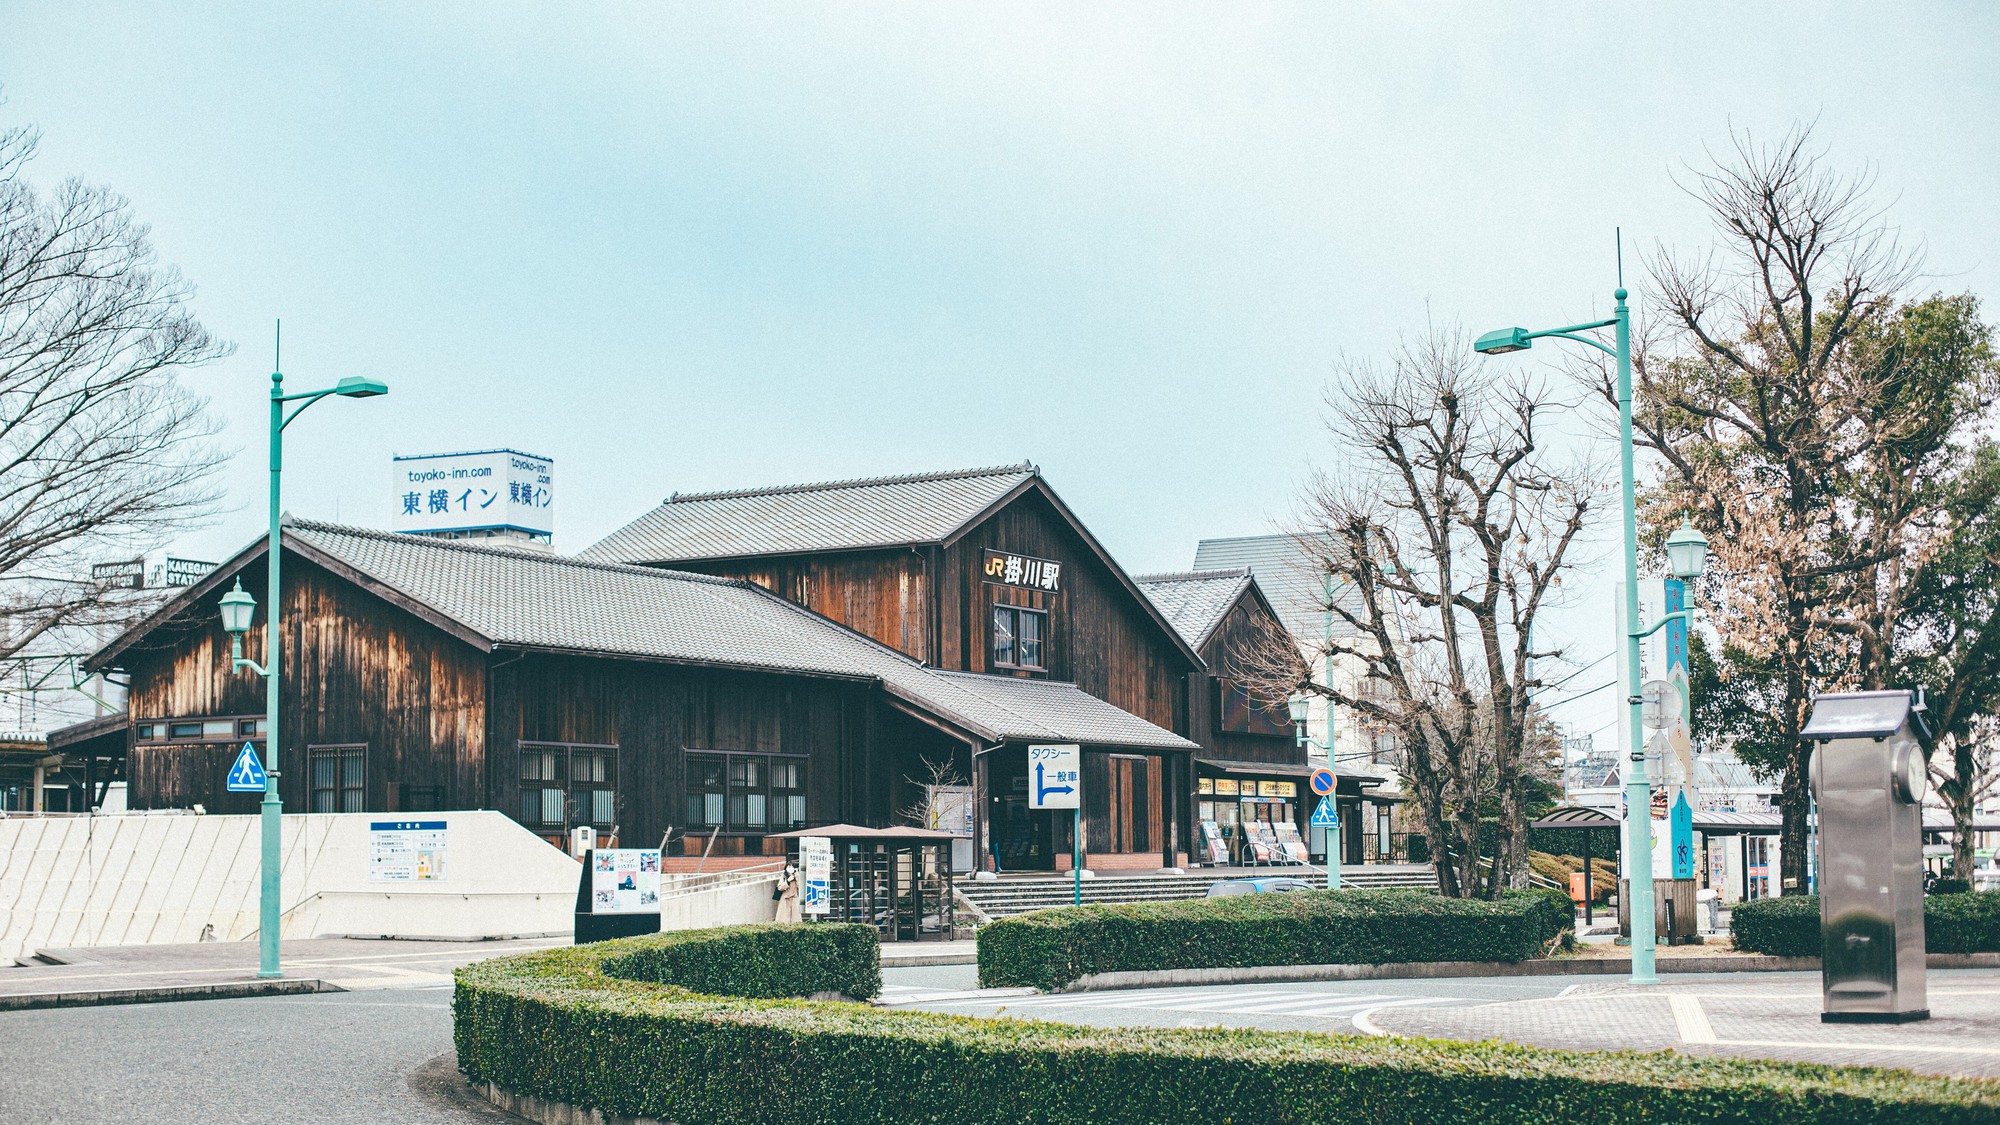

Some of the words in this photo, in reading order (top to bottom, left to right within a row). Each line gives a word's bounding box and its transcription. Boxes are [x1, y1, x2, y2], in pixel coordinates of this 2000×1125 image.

[511, 457, 547, 474] toyoko-inn
[408, 466, 492, 483] toyoko-inn.com
[401, 487, 498, 516] 東横イン
[508, 480, 553, 509] 東横イン
[168, 560, 217, 575] KAKEGAW
[1031, 748, 1071, 760] タクシー
[1046, 771, 1078, 783] 一般車
